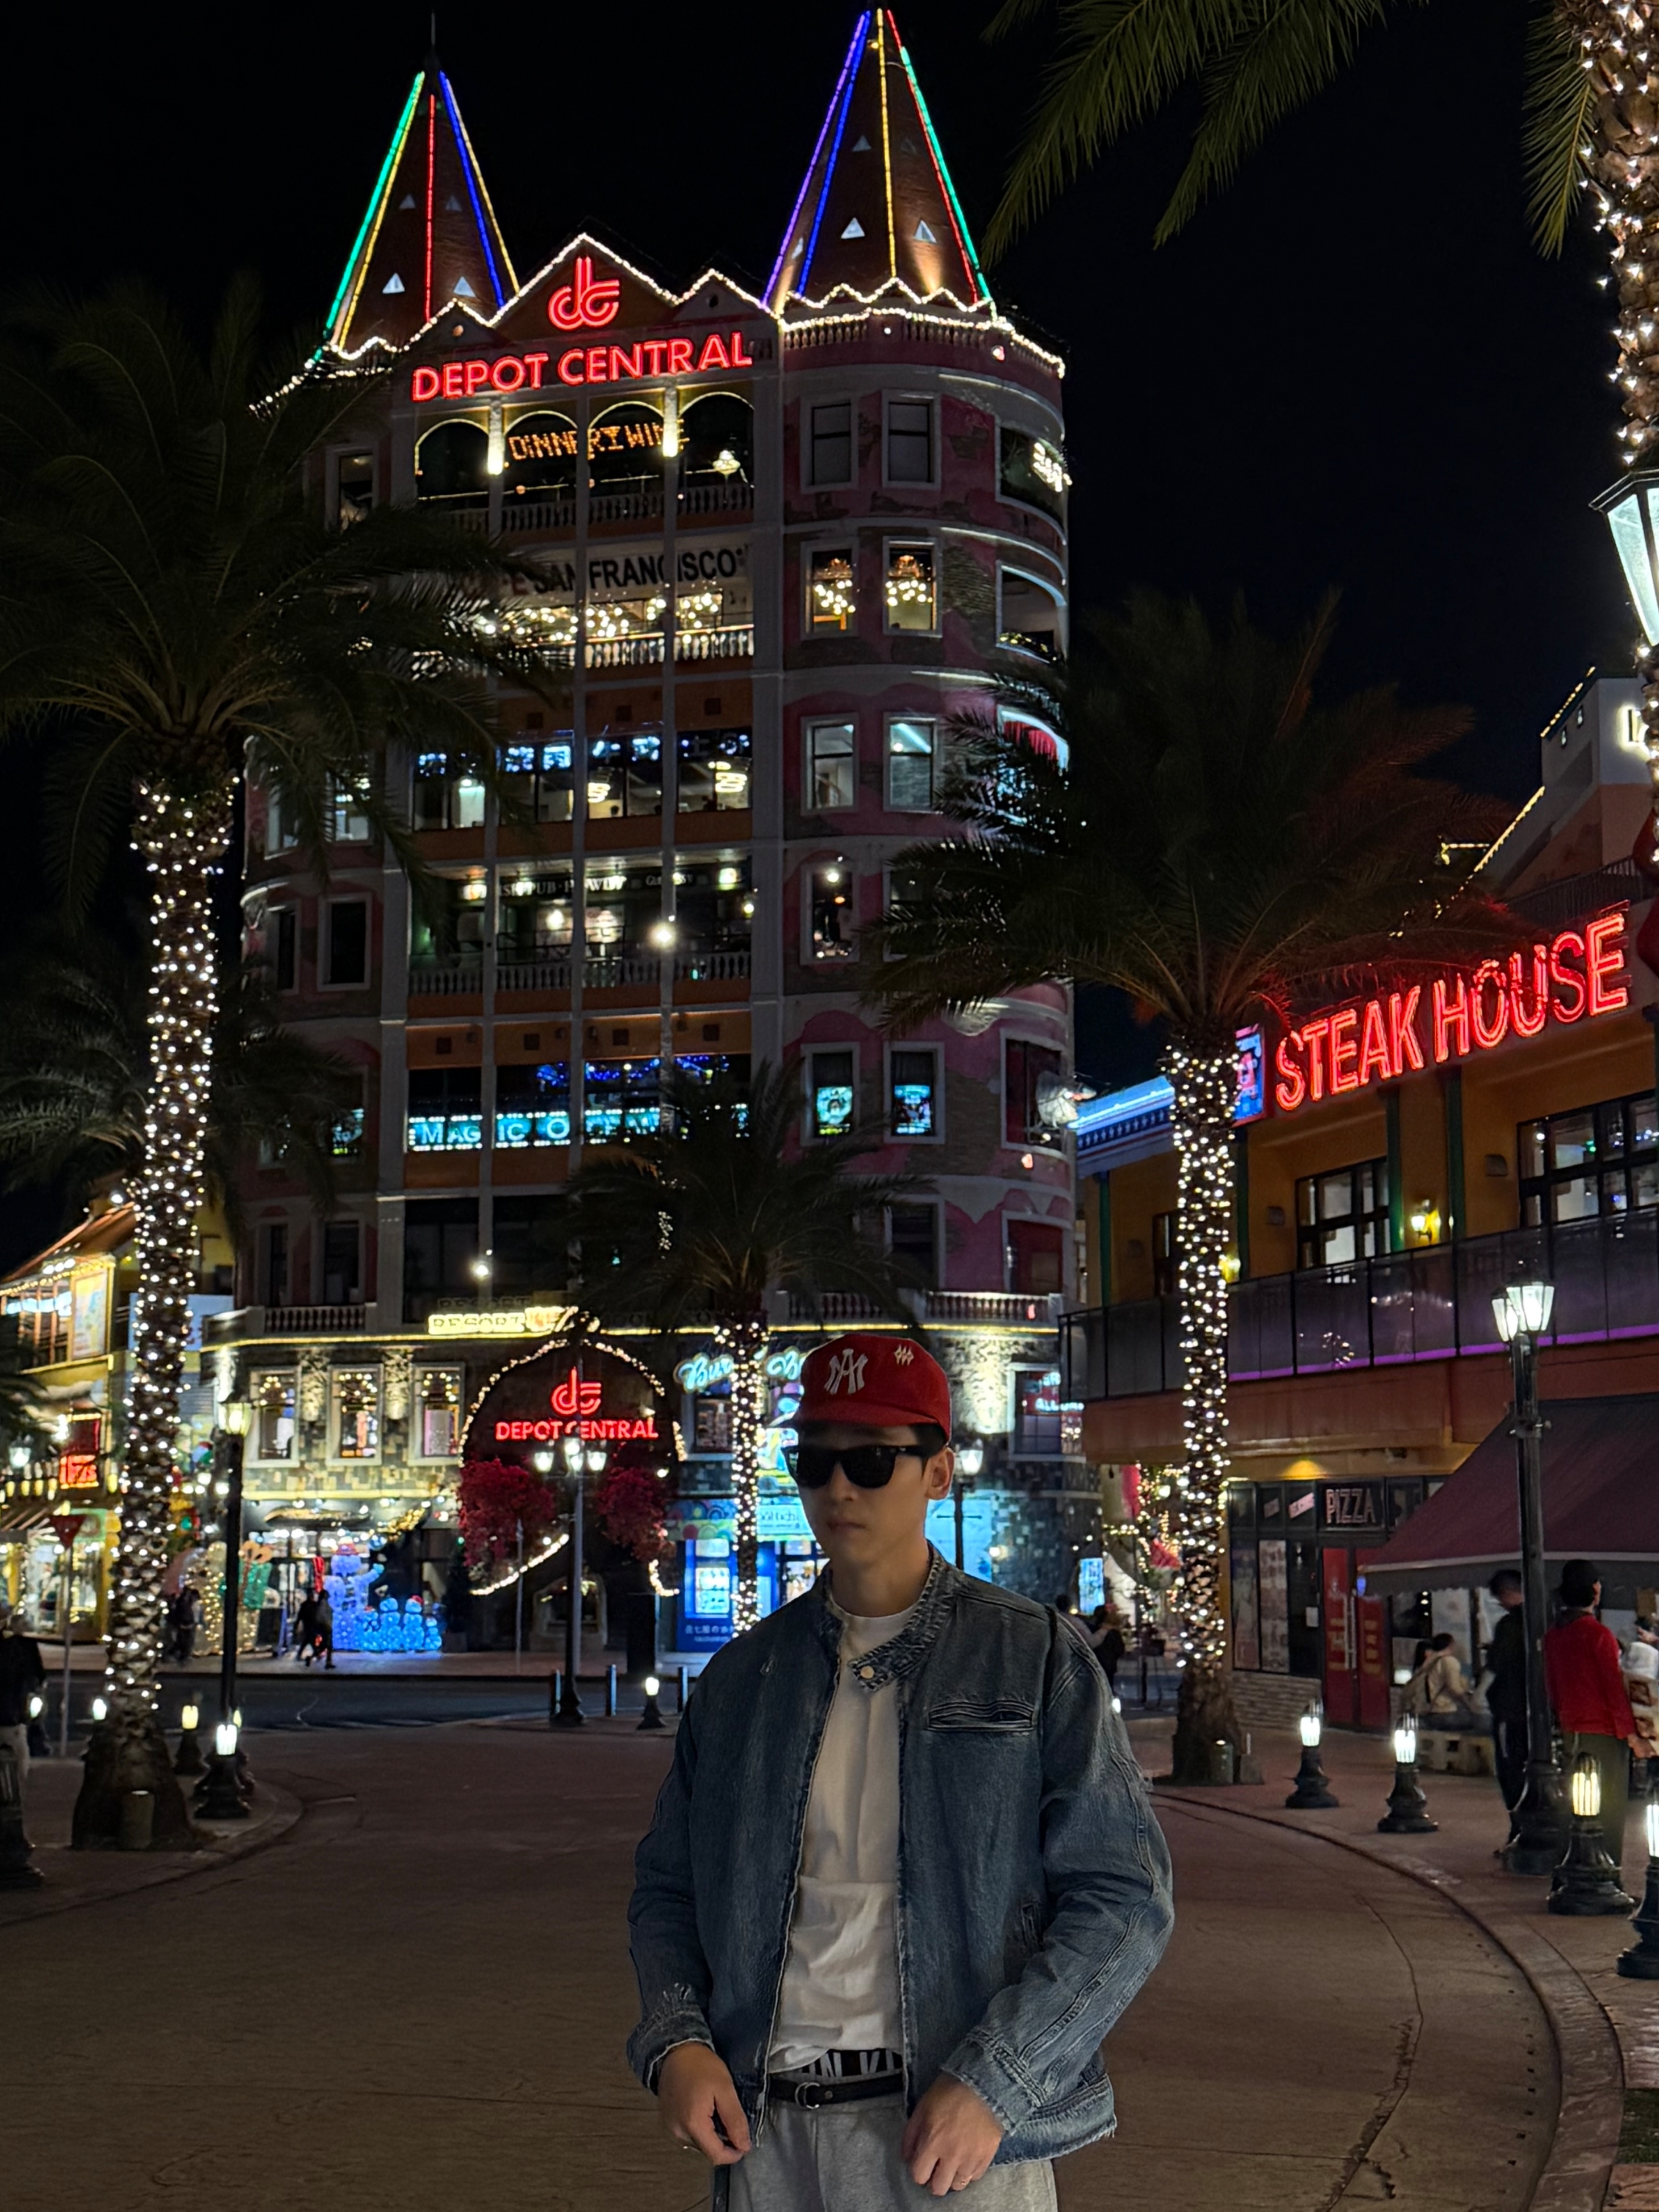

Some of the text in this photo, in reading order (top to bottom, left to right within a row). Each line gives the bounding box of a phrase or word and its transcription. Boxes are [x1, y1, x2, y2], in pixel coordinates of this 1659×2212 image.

[411, 331, 753, 403] DEPOT CENTRAL
[1275, 911, 1630, 1111] STEAK HOUSE
[495, 1422, 562, 1441] DEPOT
[1325, 1488, 1375, 1524] PIZZA
